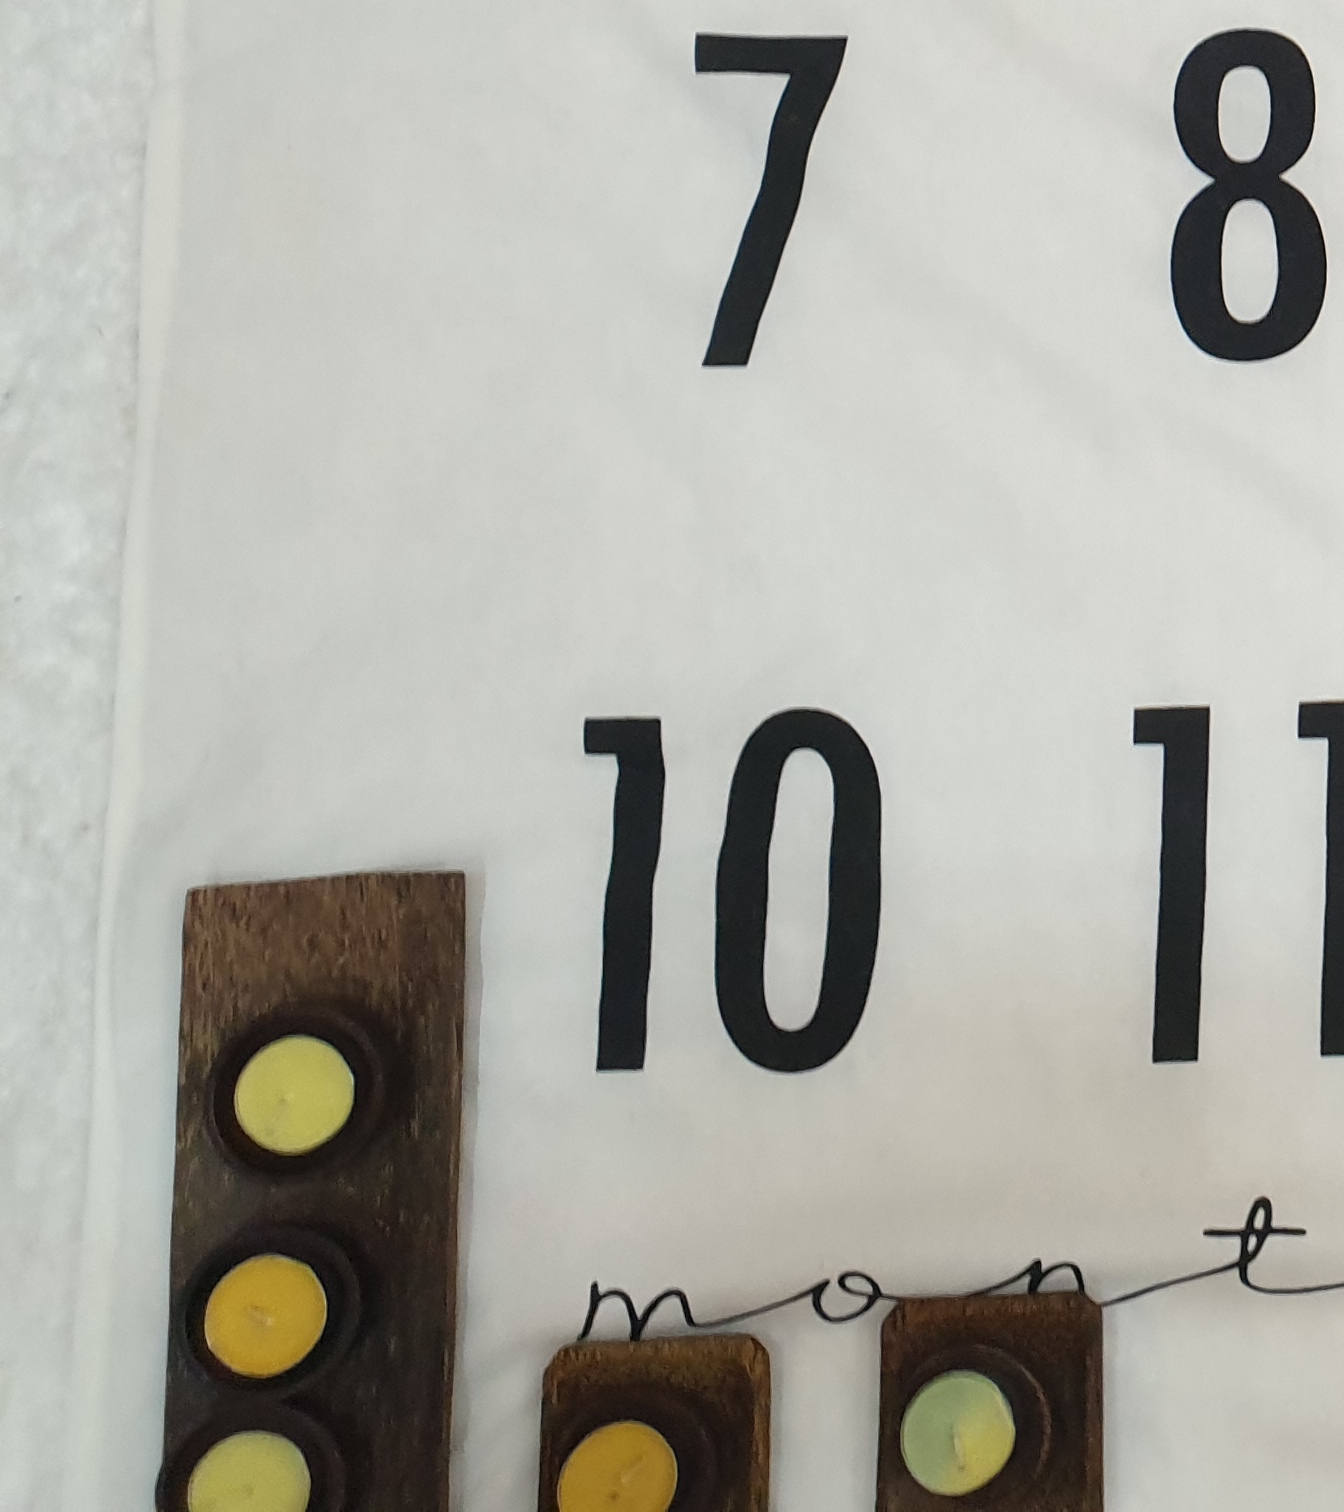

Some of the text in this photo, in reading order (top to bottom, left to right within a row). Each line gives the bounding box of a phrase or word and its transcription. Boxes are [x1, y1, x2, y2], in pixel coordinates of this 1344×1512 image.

[695, 34, 848, 367] 7
[1170, 29, 1328, 362] 8
[583, 708, 882, 1074] 10
